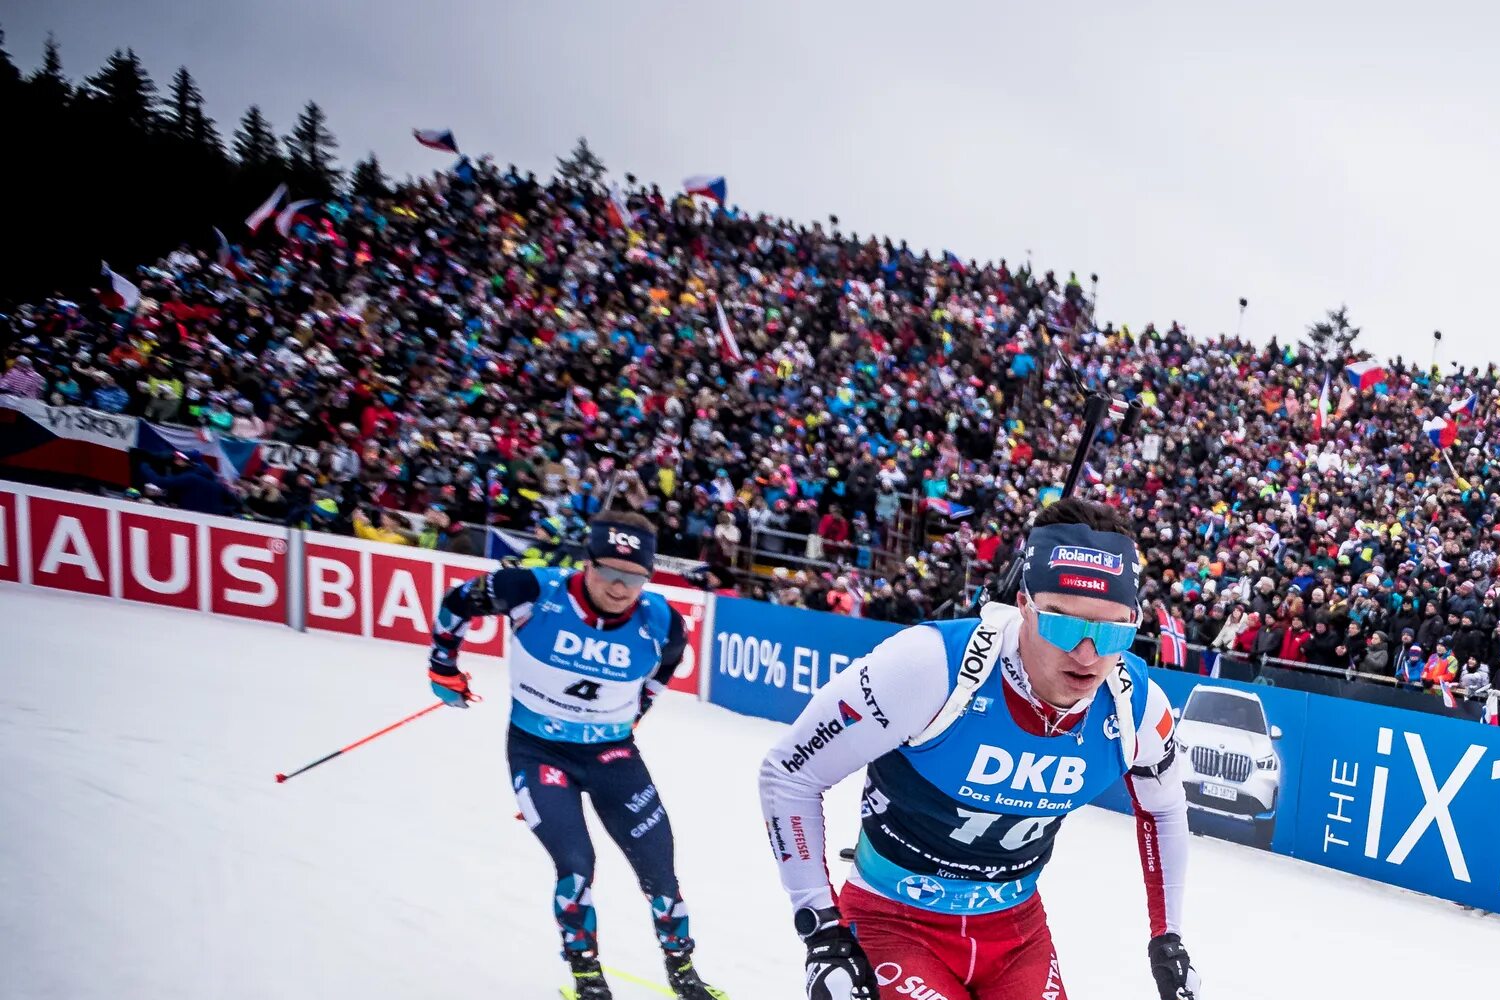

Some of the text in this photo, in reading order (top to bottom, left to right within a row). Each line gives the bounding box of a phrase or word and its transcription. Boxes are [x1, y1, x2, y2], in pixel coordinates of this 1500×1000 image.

[1058, 547, 1102, 564] Roland
[553, 629, 631, 668] DKB
[717, 631, 786, 688] 100%
[564, 678, 603, 701] 4
[859, 665, 890, 729] SCATTA
[781, 718, 845, 774] helvetia
[966, 744, 1086, 794] DKB
[958, 786, 1073, 811] Das kann Bank
[1323, 758, 1359, 853] THE
